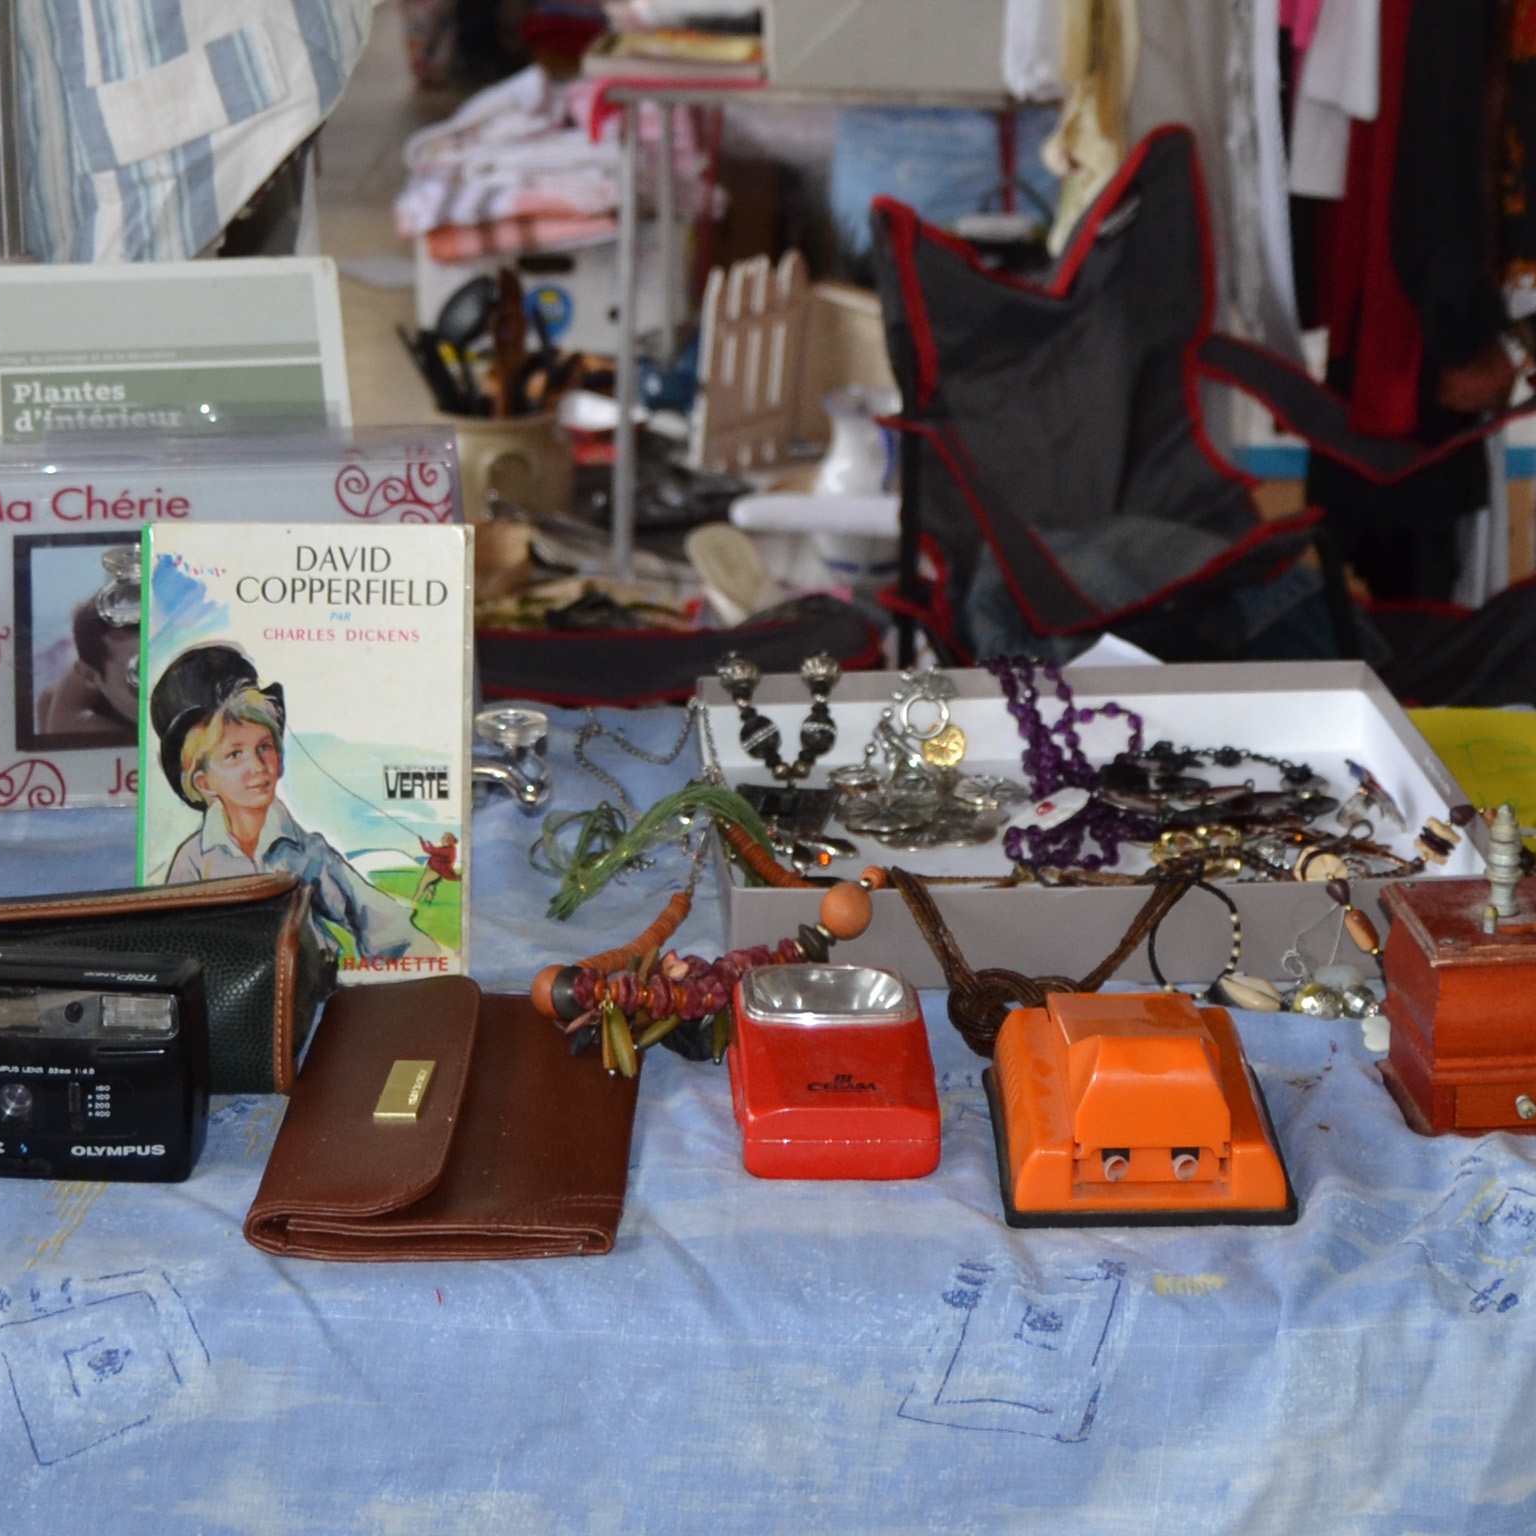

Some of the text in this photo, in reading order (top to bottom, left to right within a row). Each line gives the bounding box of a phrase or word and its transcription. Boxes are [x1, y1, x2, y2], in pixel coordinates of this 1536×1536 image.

[13, 381, 126, 405] Plantes
[14, 405, 183, 434] d'intérieur
[50, 484, 191, 521] Chérie
[296, 545, 392, 574] DAVID
[235, 575, 449, 607] COPPERFIELD
[329, 611, 352, 622] PAR
[263, 628, 421, 644] CHARLES DICKENS
[384, 771, 449, 799] VERTE
[342, 956, 450, 972] HACHETTE
[22, 1066, 44, 1075] LENS
[95, 1093, 111, 1101] 100
[95, 1102, 111, 1110] 200
[70, 1144, 167, 1158] OLYMPUS
